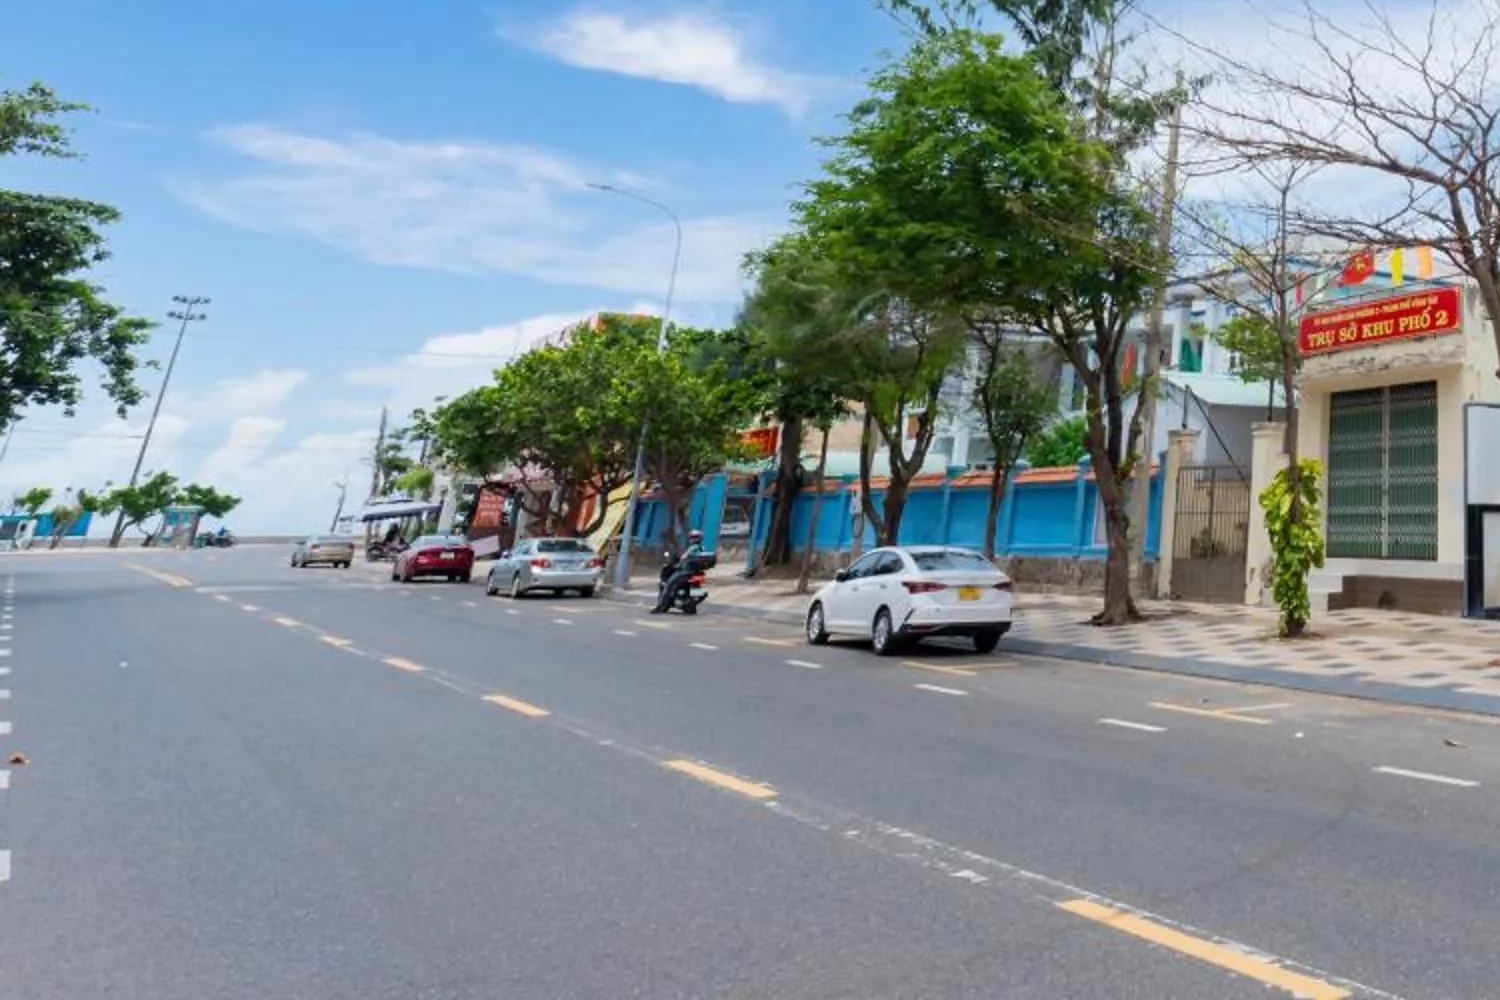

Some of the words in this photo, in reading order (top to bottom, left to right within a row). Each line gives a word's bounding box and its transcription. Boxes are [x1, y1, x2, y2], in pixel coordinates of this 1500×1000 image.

[1362, 319, 1395, 338] KHU
[1398, 306, 1431, 332] PHỐ
[1435, 310, 1449, 326] 2
